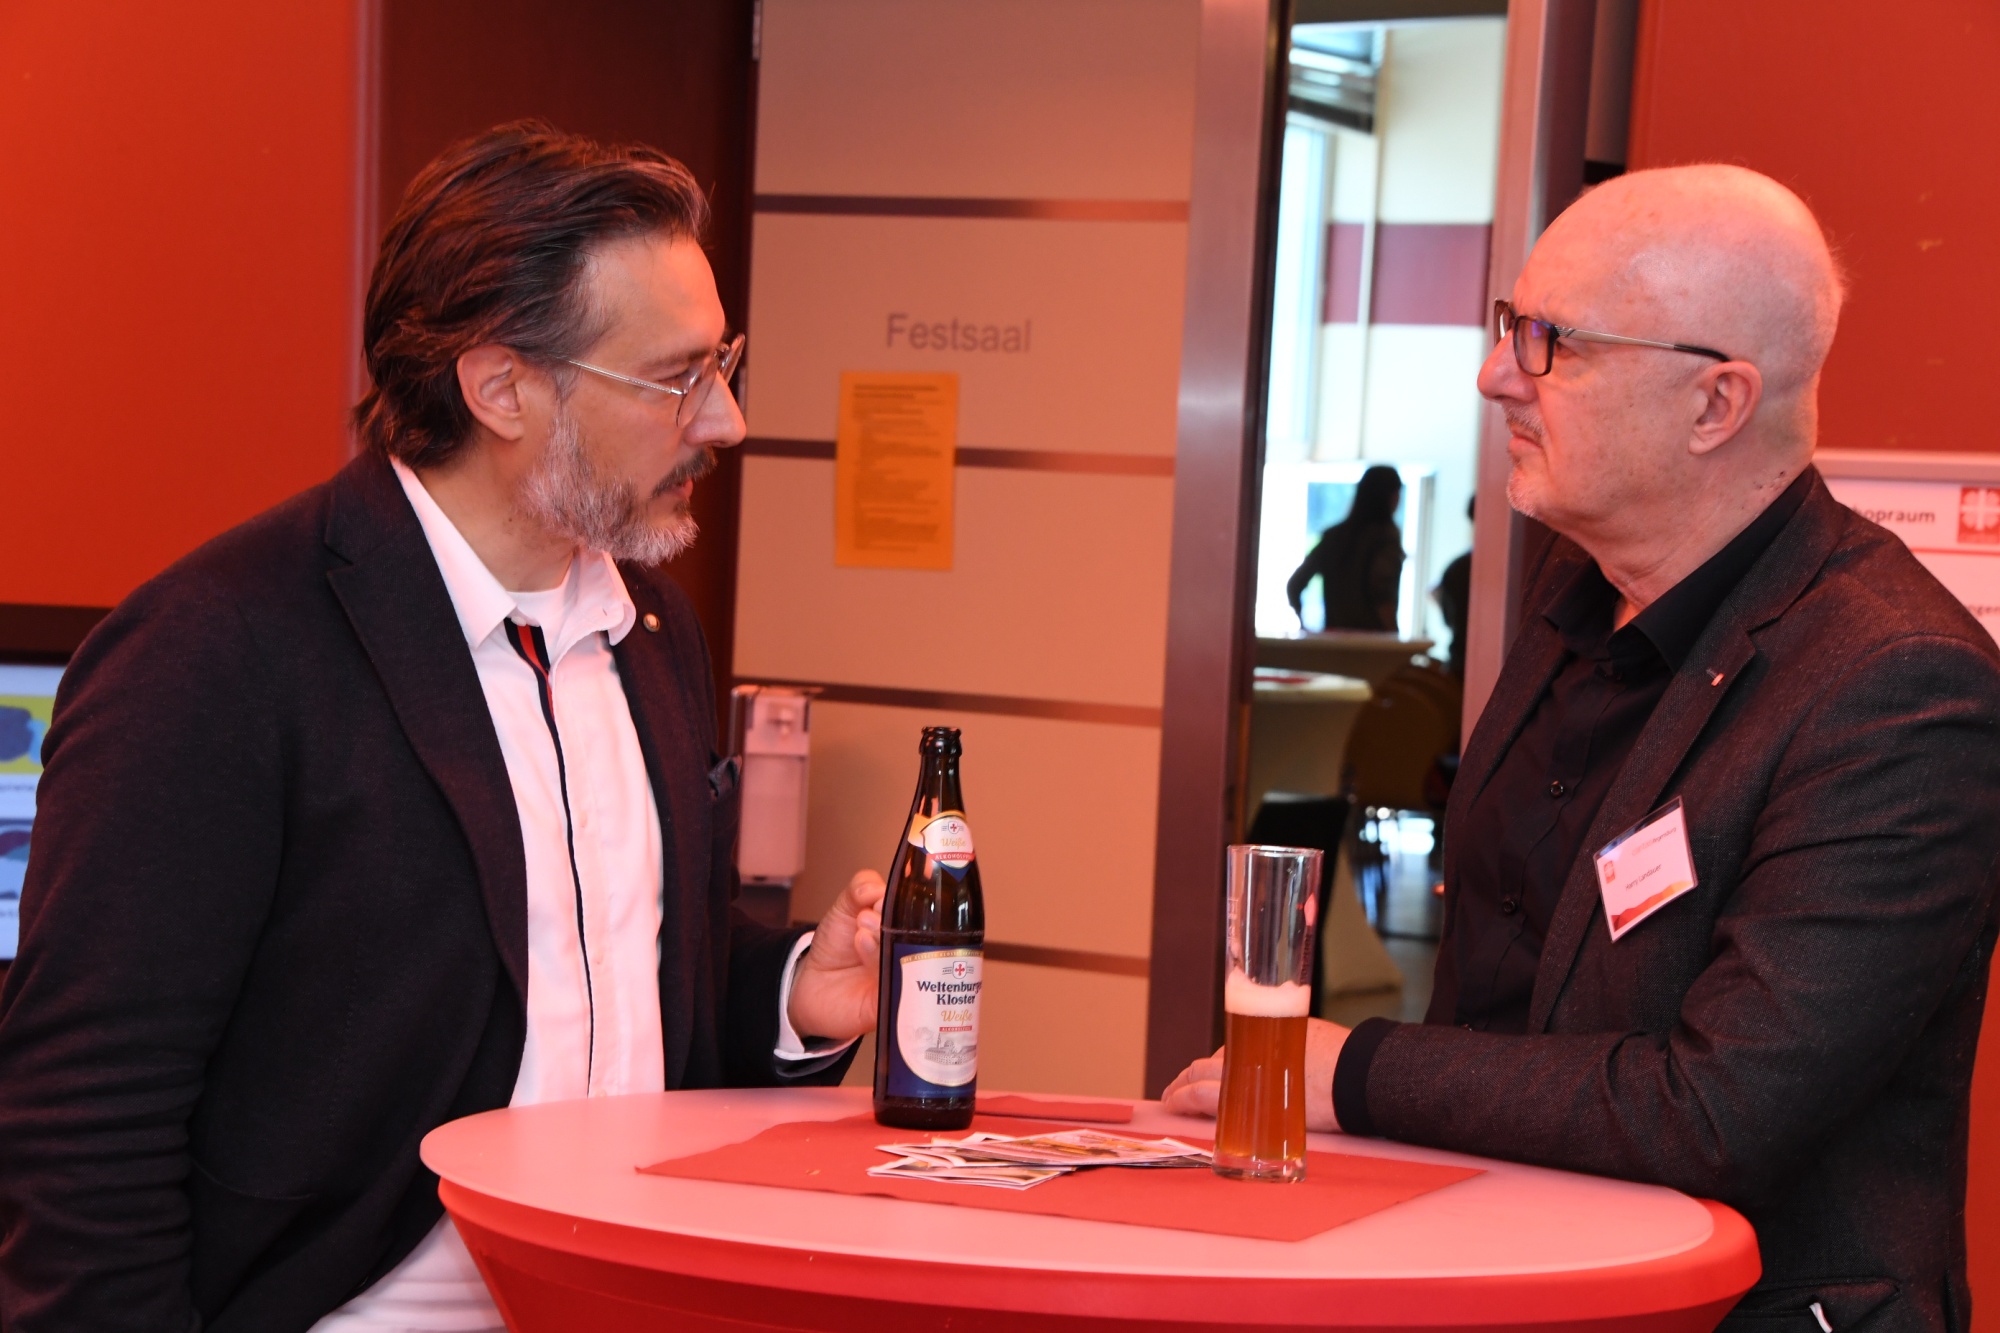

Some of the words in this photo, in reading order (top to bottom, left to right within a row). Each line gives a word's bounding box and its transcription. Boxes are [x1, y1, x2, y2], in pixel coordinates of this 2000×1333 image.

[887, 313, 1031, 352] Festsaal
[1853, 503, 1936, 524] opraum
[936, 993, 976, 1006] Kloster
[940, 1009, 973, 1025] Weiße
